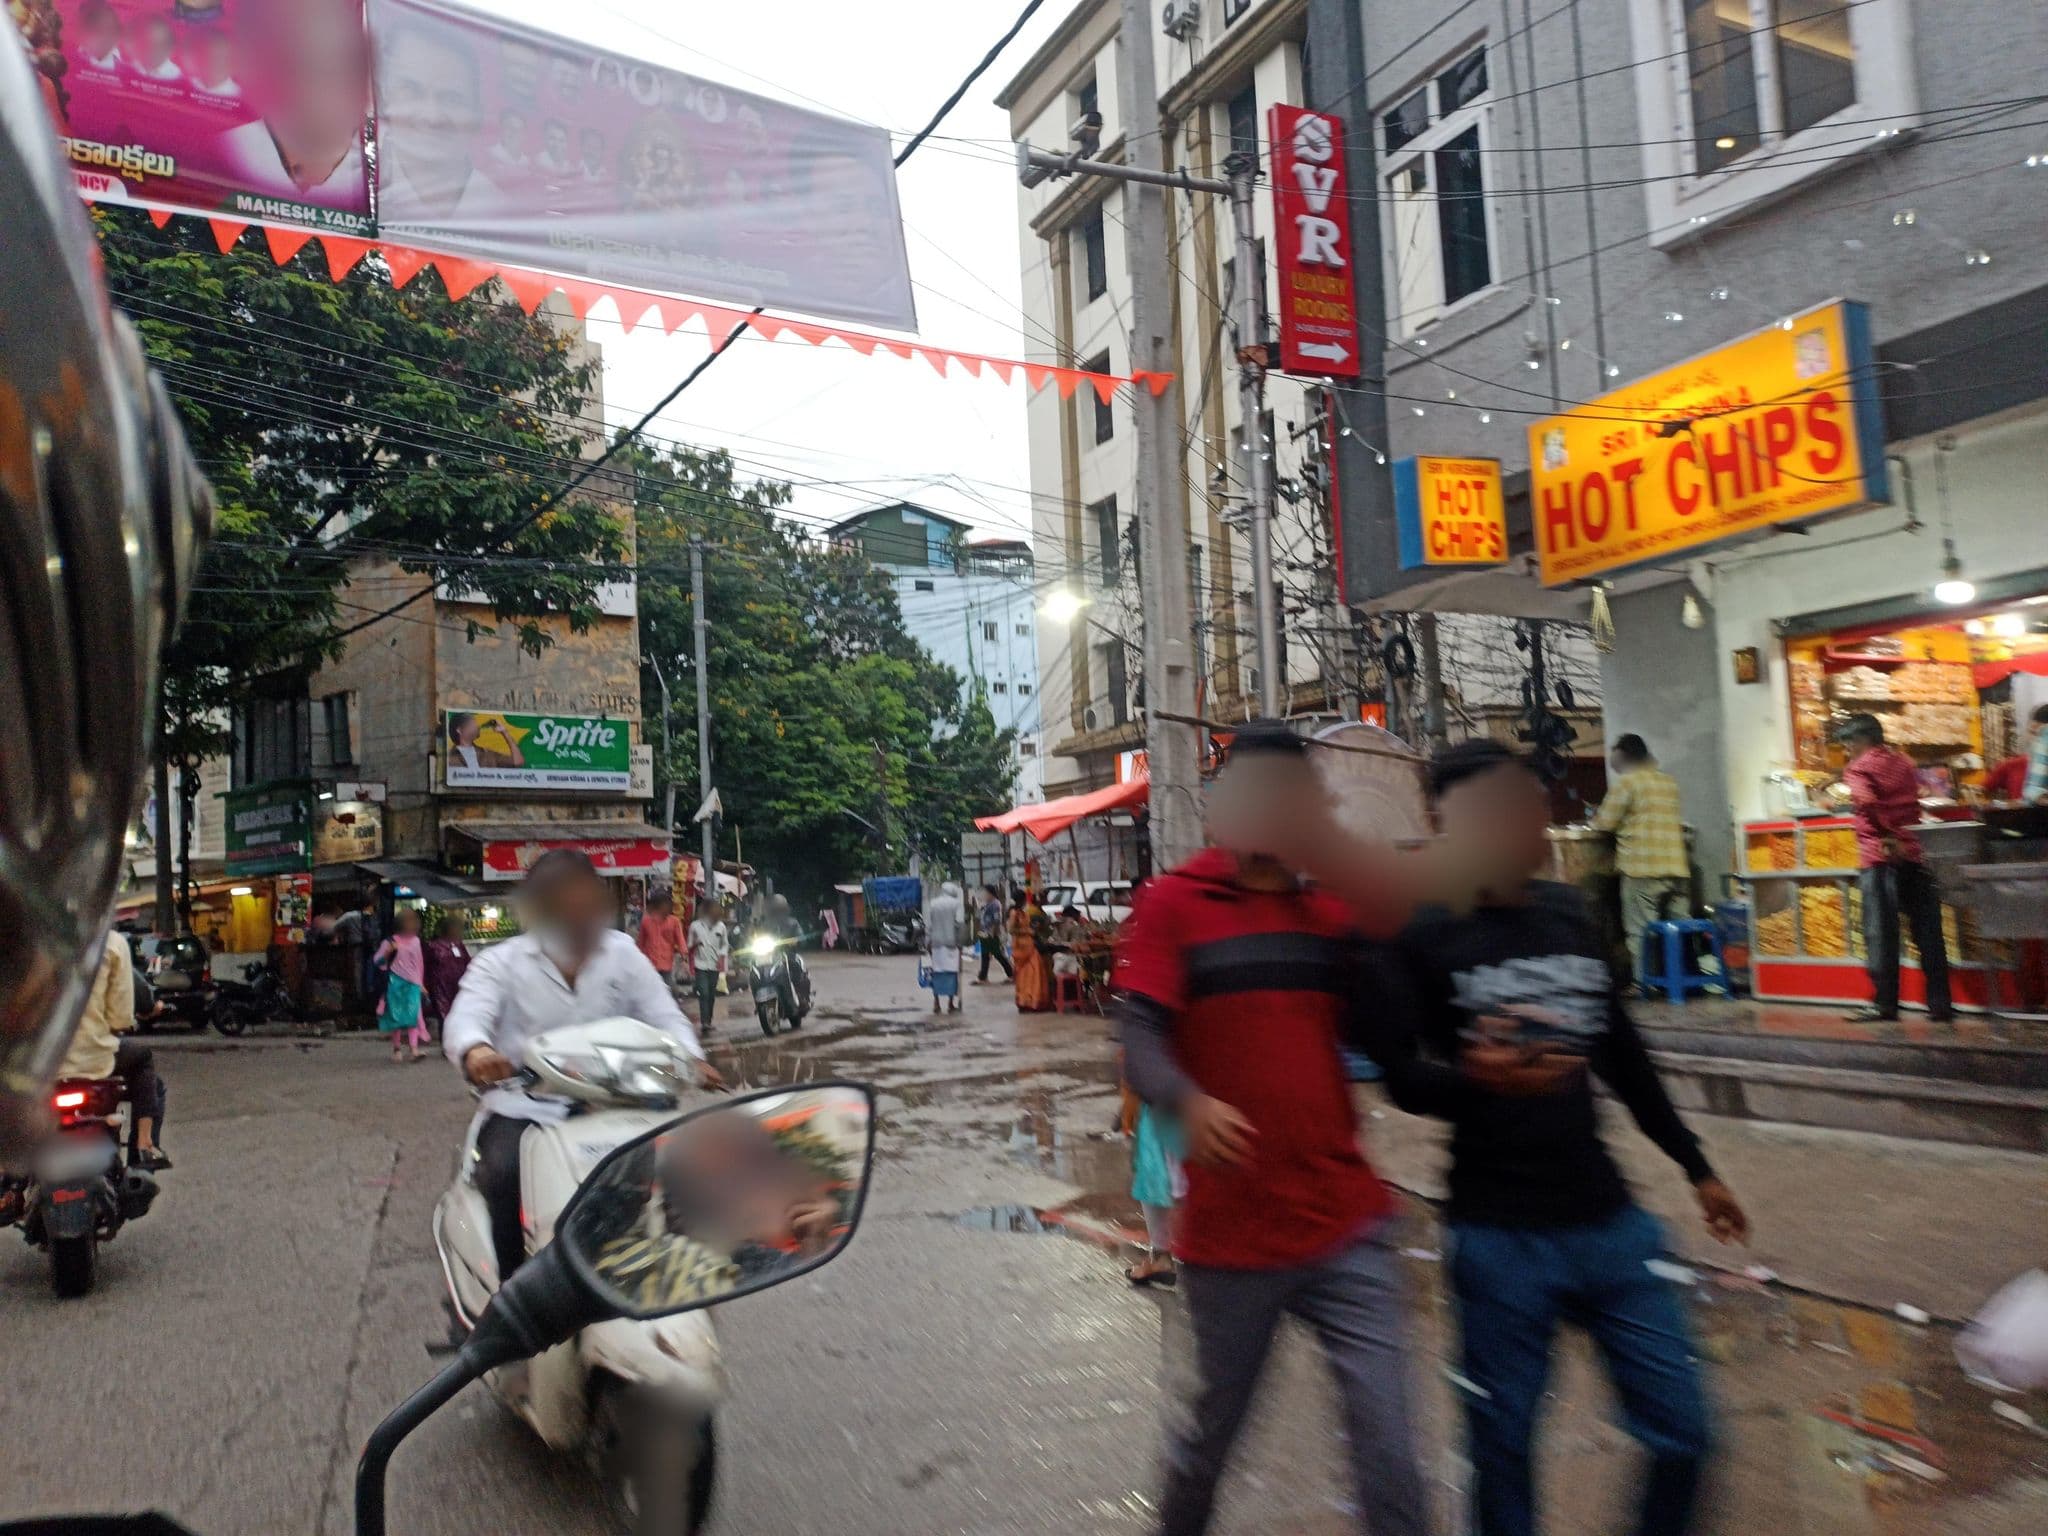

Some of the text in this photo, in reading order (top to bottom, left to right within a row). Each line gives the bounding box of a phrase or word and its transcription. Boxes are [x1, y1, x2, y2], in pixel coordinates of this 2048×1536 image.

[236, 194, 317, 222] MAHESH
[322, 209, 374, 232] YADA
[1543, 458, 1643, 554] HOT
[1667, 391, 1844, 516] CHIPS
[1436, 480, 1487, 516] HOT
[1430, 520, 1505, 558] CHIPS
[533, 718, 616, 751] Sprite
